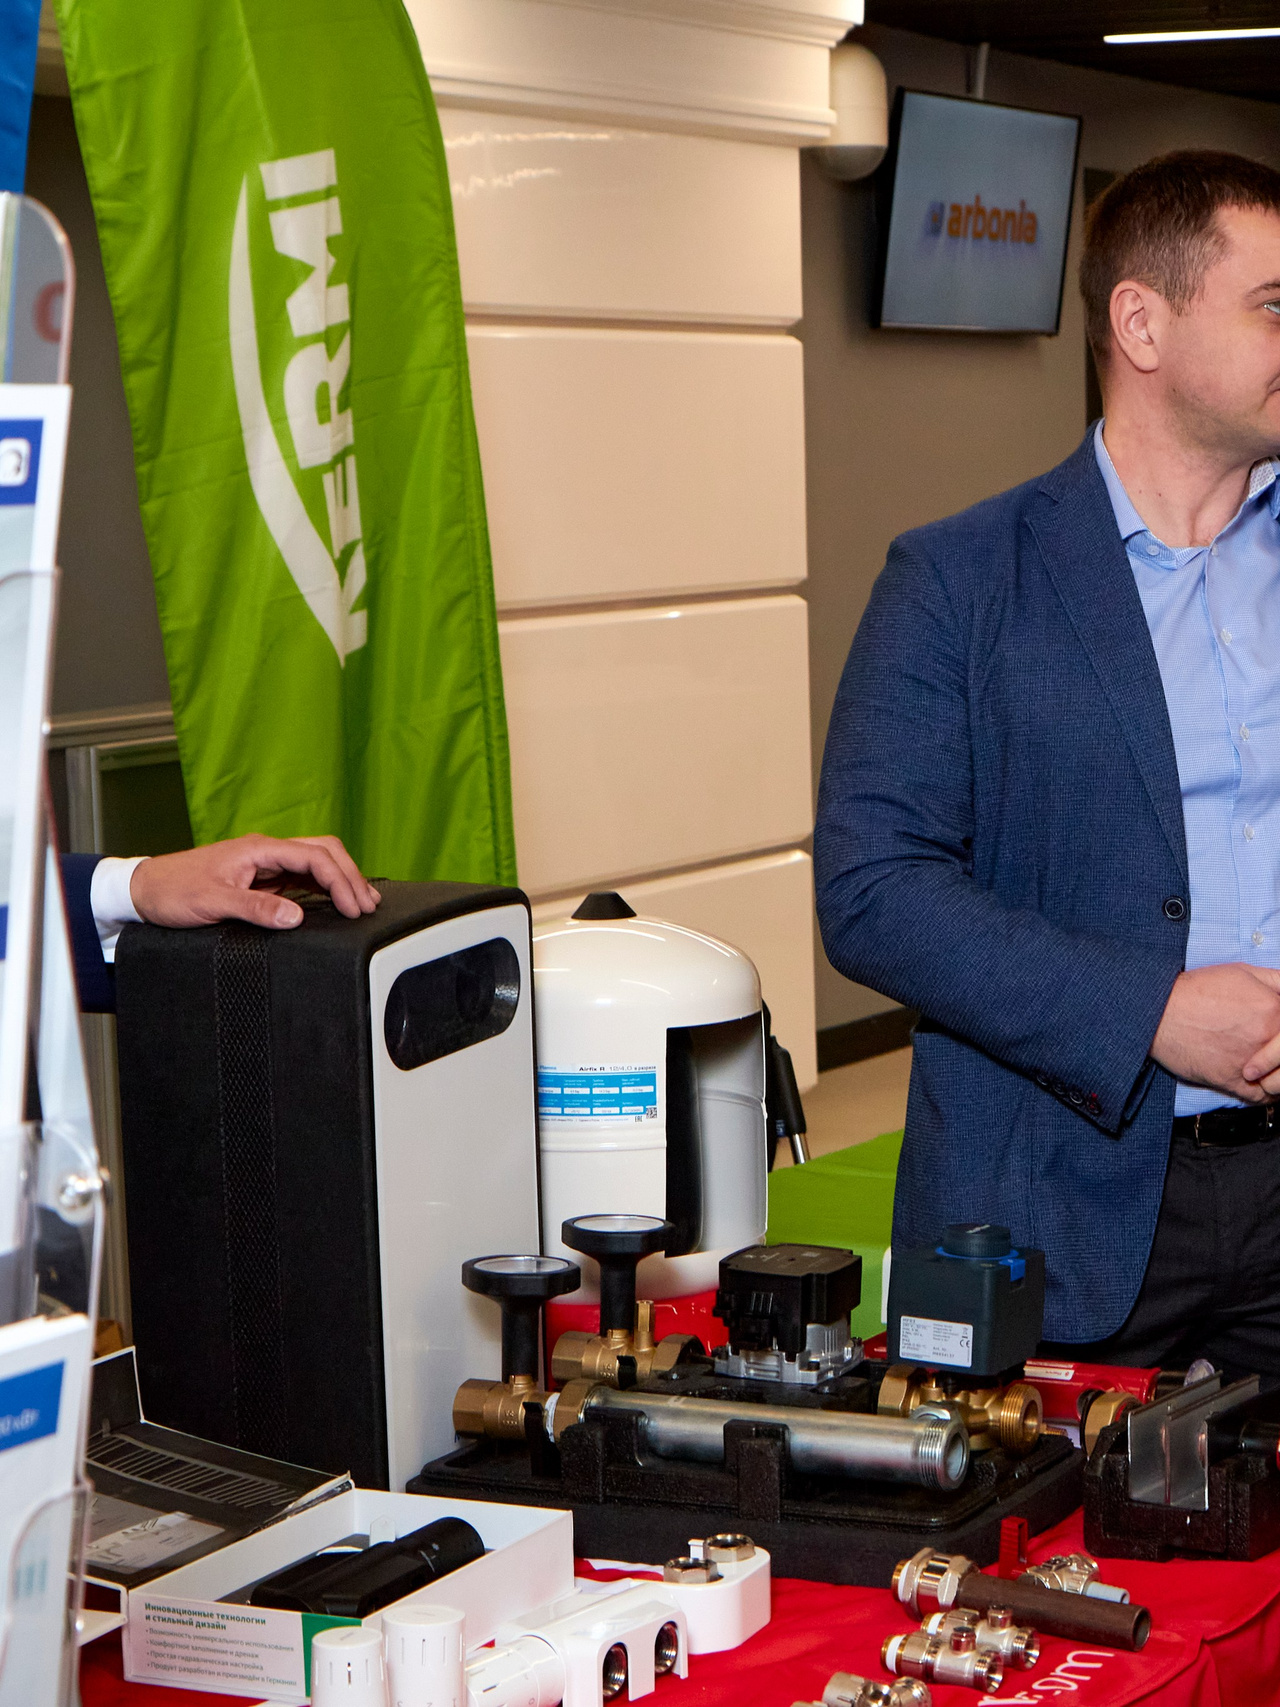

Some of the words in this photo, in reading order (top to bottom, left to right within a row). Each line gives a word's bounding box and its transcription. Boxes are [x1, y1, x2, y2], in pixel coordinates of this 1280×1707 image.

[948, 194, 1038, 244] arbonia
[229, 148, 368, 667] KERMI
[145, 1602, 215, 1619] Инновационные
[216, 1612, 266, 1625] технологии
[152, 1615, 194, 1627] стильный
[195, 1619, 227, 1631] дизайн
[149, 1627, 191, 1640] Возможность
[150, 1650, 177, 1660] Простая
[230, 1659, 264, 1671] настройка
[151, 1661, 177, 1673] Продукт
